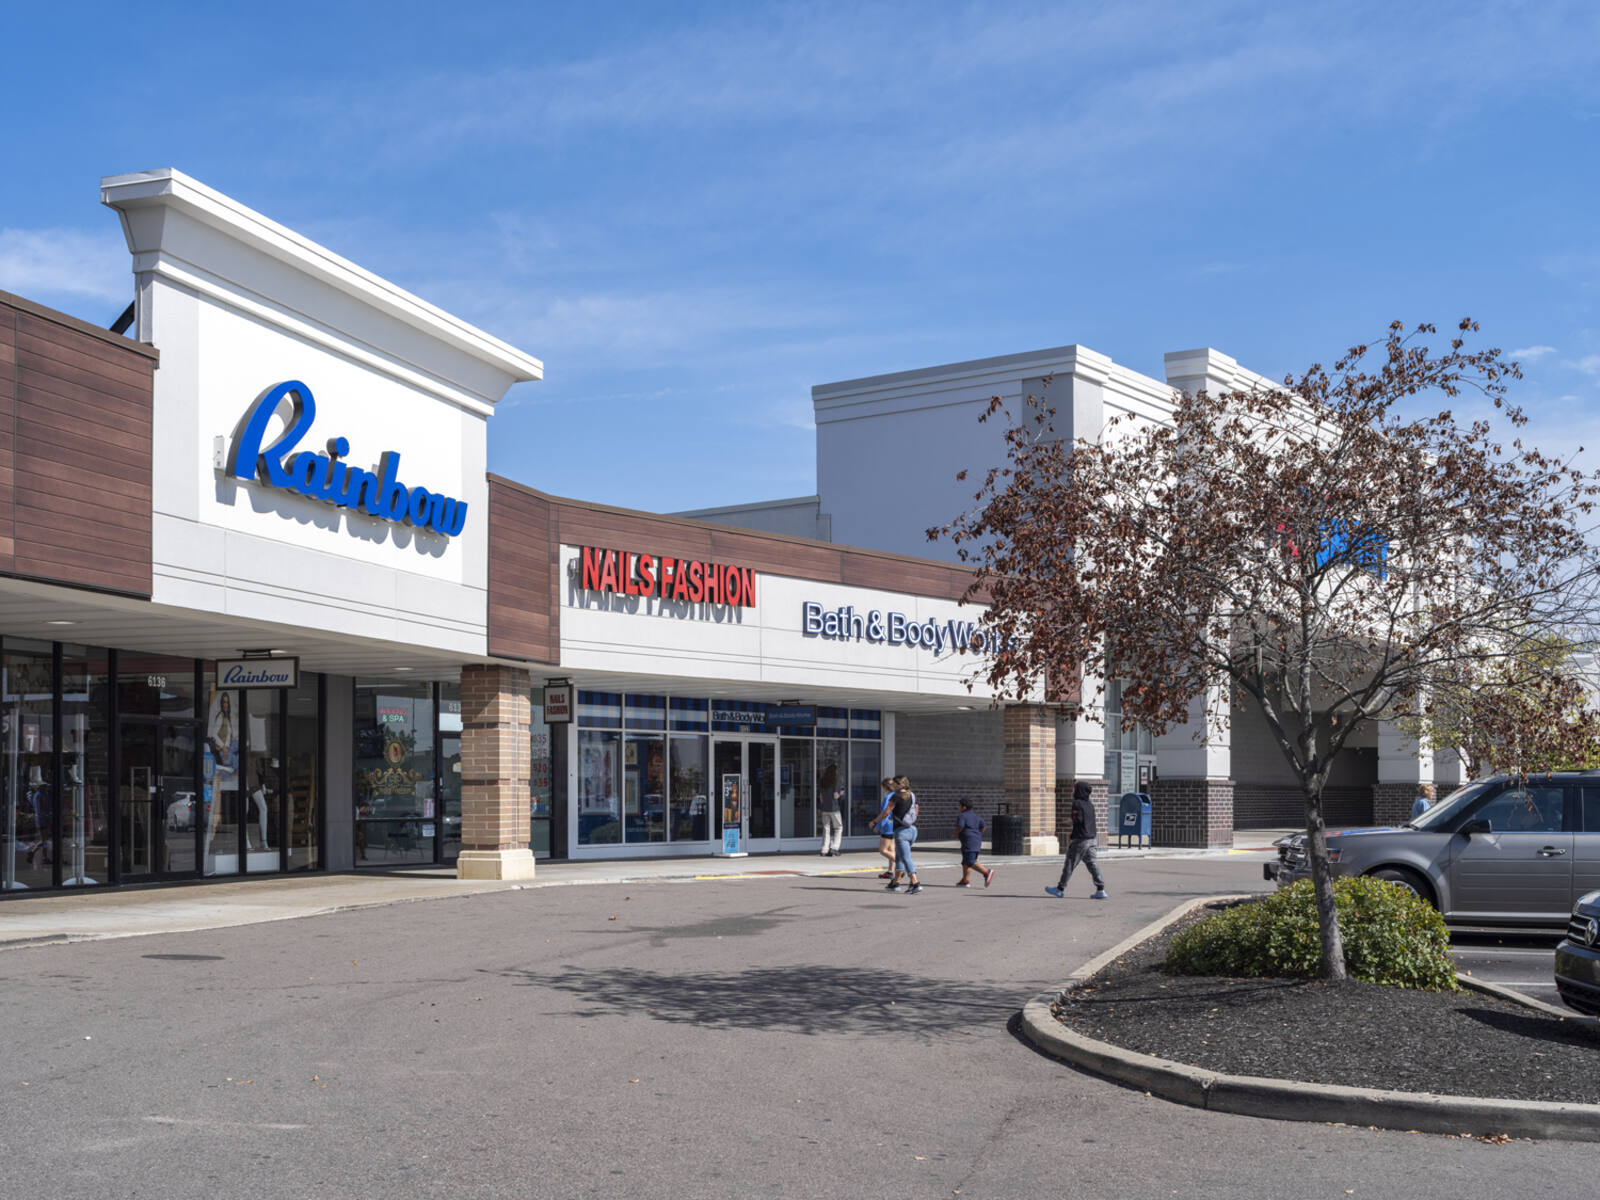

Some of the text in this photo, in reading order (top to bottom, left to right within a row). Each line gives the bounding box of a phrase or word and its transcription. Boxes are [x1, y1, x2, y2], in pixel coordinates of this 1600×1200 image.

[226, 380, 468, 537] Rainbow
[580, 546, 756, 608] NAILS FASHION
[803, 601, 864, 637] Bath
[869, 609, 887, 640] &
[888, 611, 948, 652] Body
[147, 675, 166, 688] 6136
[223, 664, 289, 684] Rainbow
[549, 694, 566, 704] NAILS
[546, 705, 569, 715] FASHION
[388, 714, 405, 723] SPA
